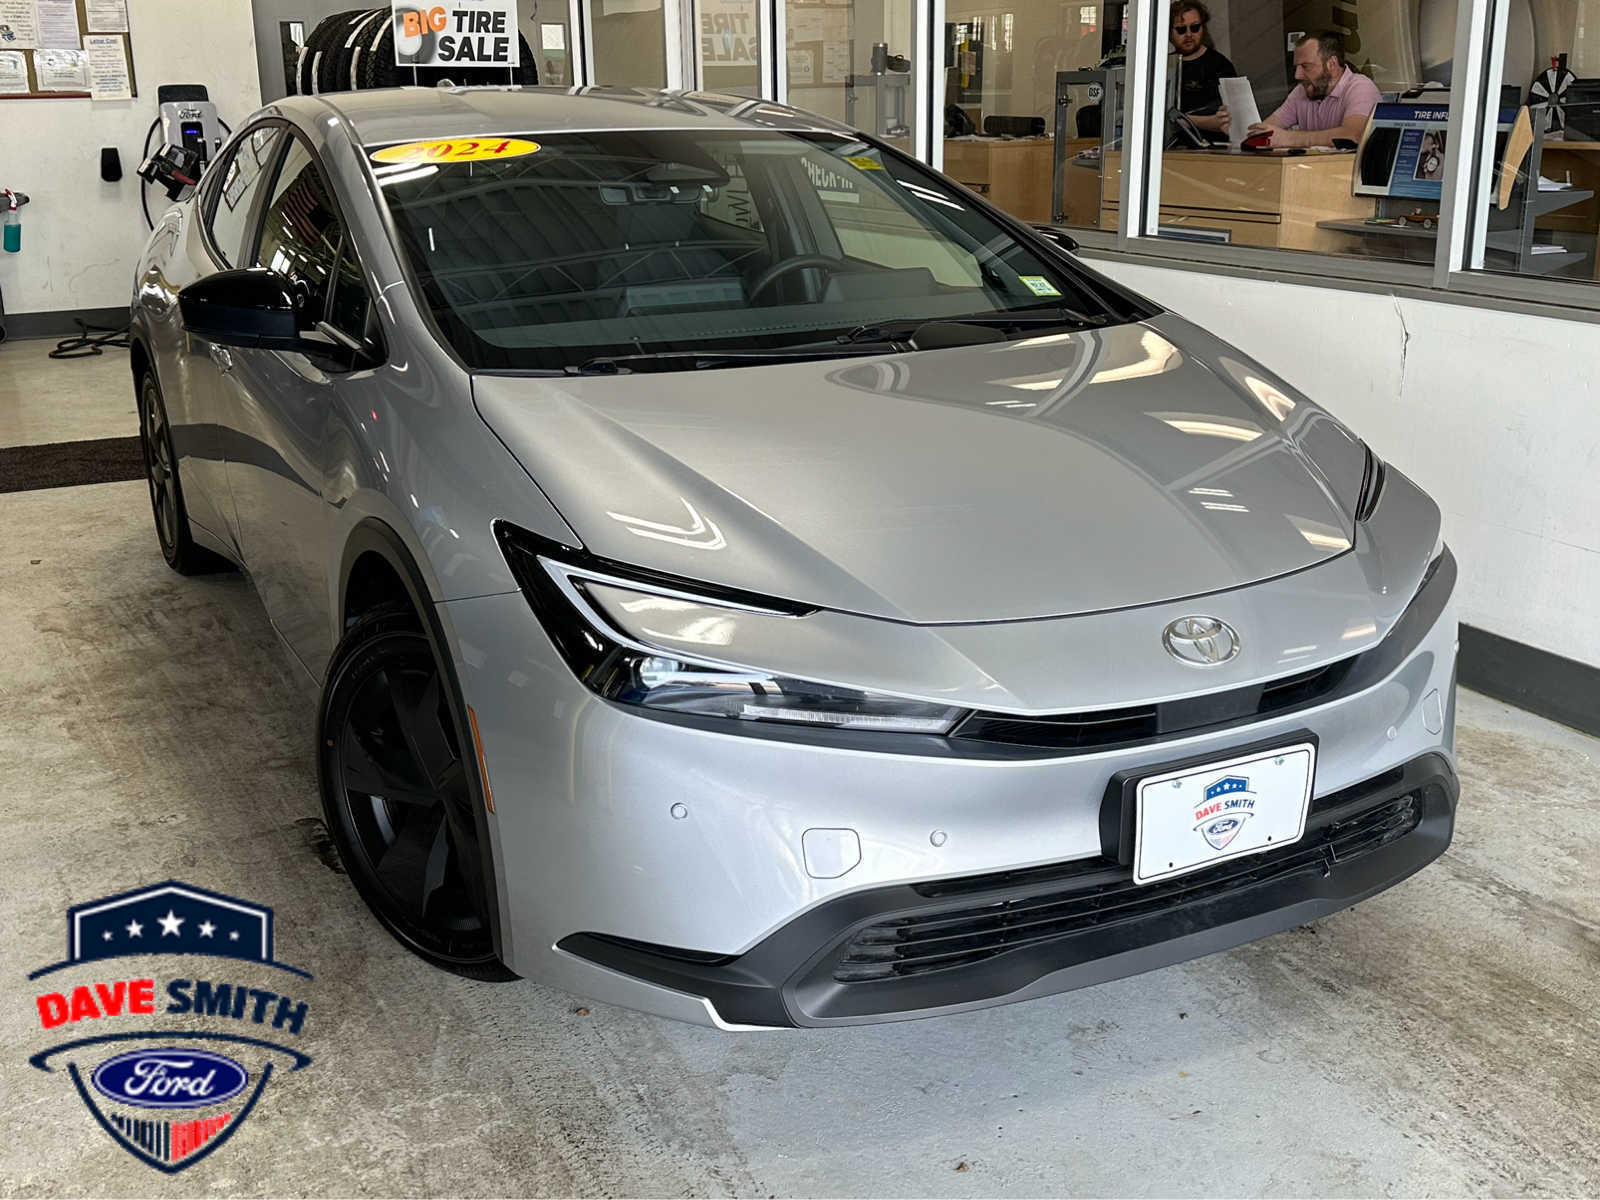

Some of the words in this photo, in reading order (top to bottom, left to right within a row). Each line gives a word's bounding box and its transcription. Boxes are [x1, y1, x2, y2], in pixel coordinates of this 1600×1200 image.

[403, 7, 446, 38] BIG
[453, 10, 506, 33] TIRE
[438, 36, 509, 62] SALE
[179, 109, 202, 119] Ford
[1414, 110, 1432, 119] TIRE
[1195, 802, 1222, 820] DAVE
[1224, 799, 1255, 810] SMITH
